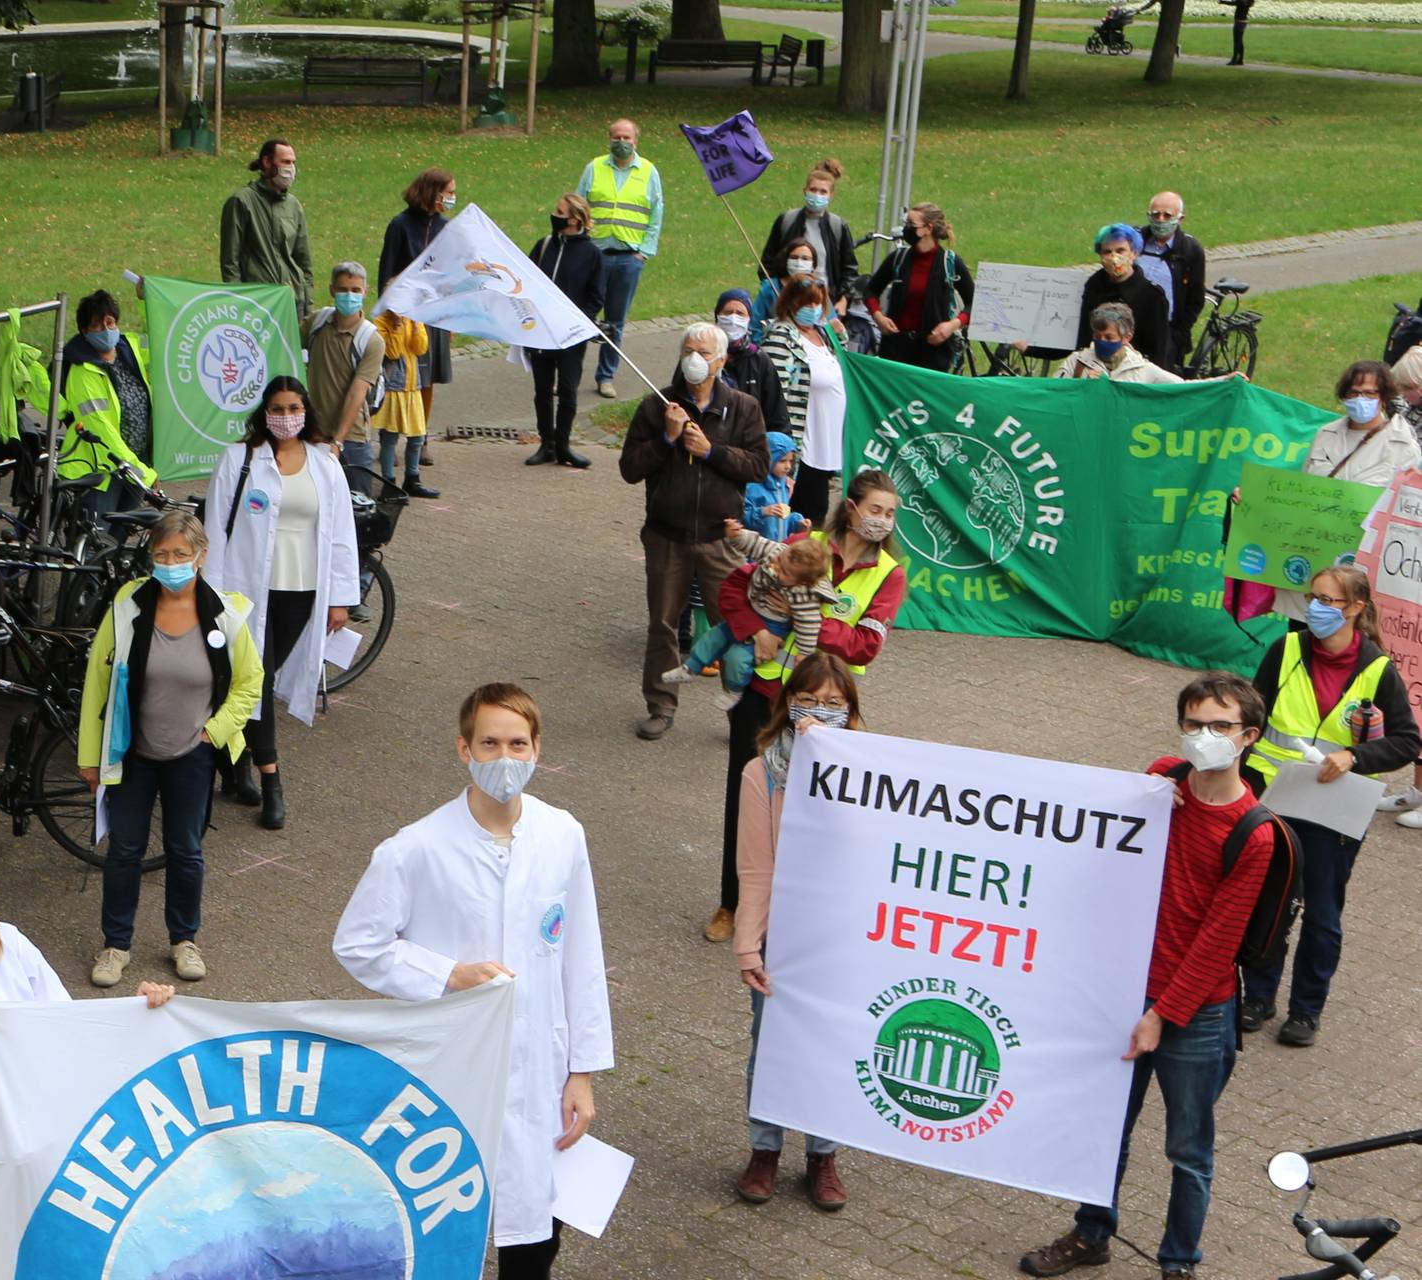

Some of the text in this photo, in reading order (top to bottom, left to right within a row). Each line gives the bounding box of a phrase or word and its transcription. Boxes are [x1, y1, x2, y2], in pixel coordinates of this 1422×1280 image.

[702, 144, 730, 163] FOR
[709, 162, 736, 182] LIFE
[177, 304, 272, 384] CHRISTIANS FOR
[173, 453, 194, 464] Wir
[858, 400, 1065, 555] ENTS 4 FUTURE
[1129, 422, 1310, 464] Suppor
[809, 761, 1147, 854] KLIMASCHUTZ
[891, 842, 1032, 909] HIER!
[866, 902, 1038, 973] JETZT!
[867, 977, 1021, 1050] RUNDER TISCH
[855, 1059, 1015, 1143] KLIMANOTSTAND
[898, 1089, 960, 1114] Aachen
[47, 1038, 485, 1236] HEALTH FOR
